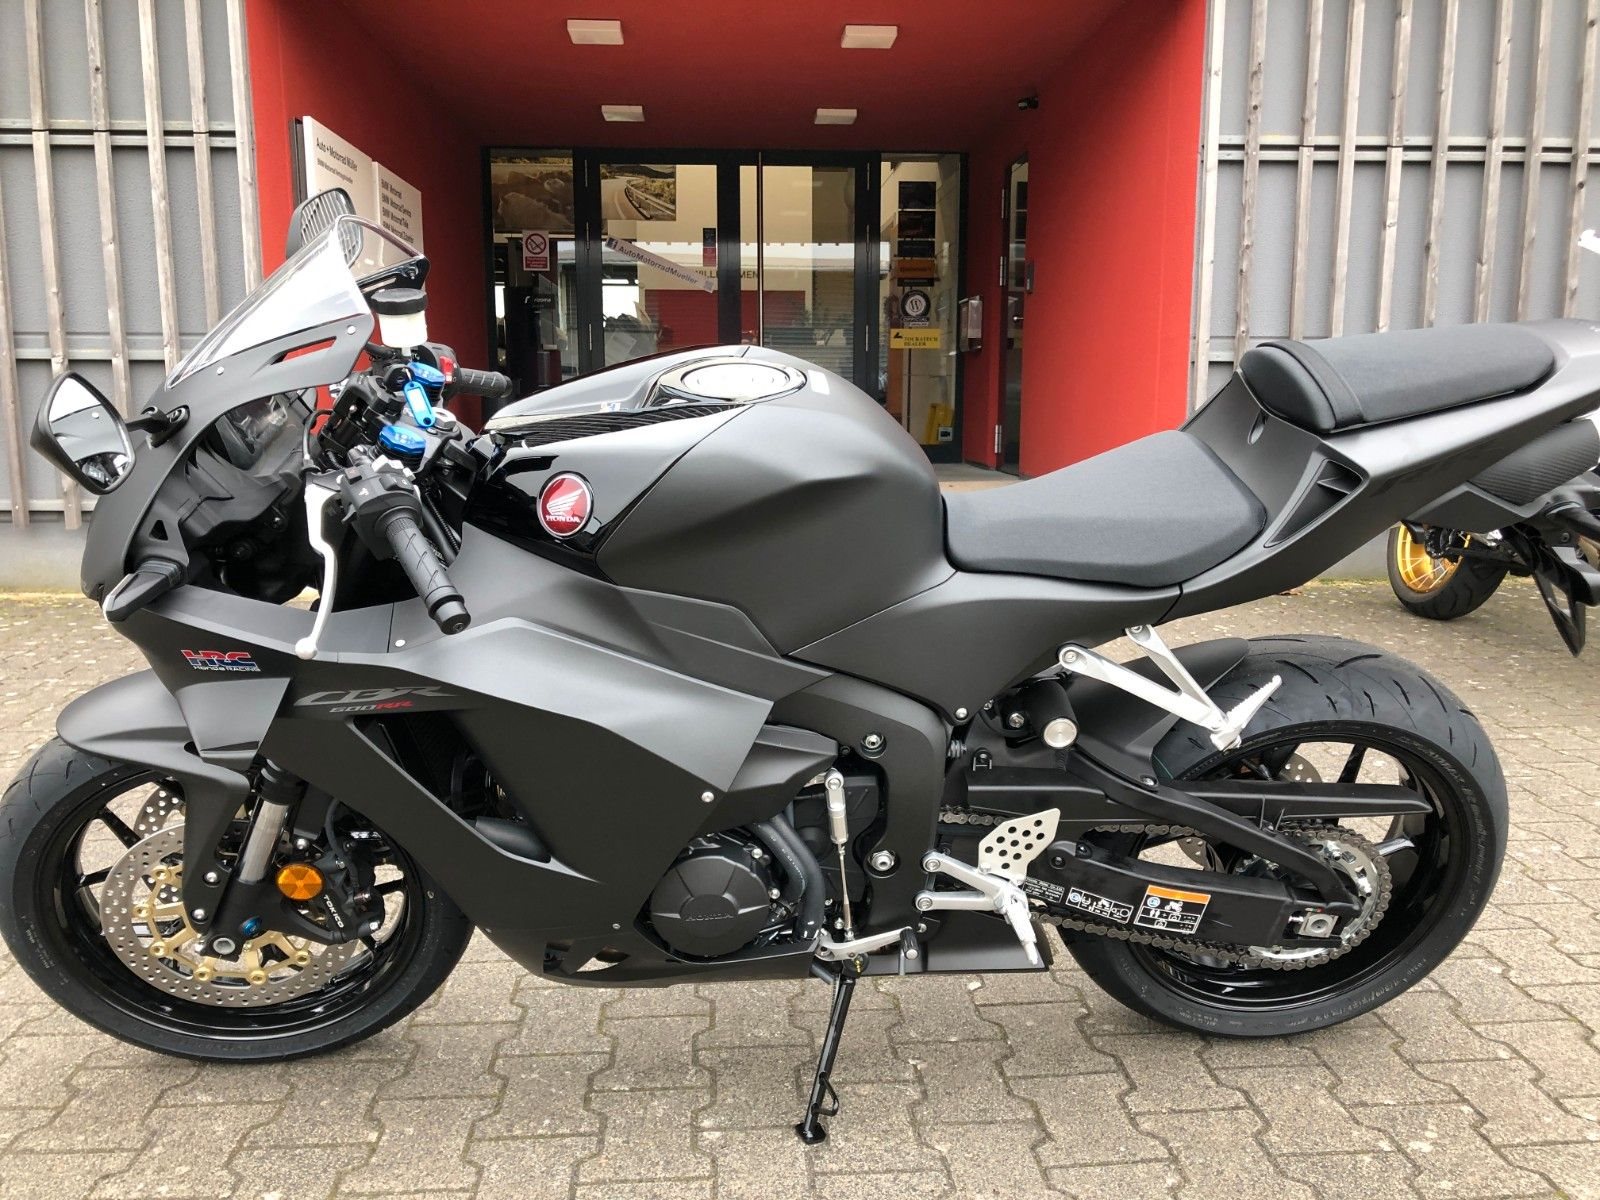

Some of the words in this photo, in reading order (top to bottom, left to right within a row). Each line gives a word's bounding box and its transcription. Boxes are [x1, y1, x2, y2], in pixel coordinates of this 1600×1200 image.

[618, 245, 698, 284] AutoMotorradMueller
[545, 515, 581, 523] HONDA
[180, 649, 259, 668] HRC
[293, 685, 459, 706] CBR
[328, 700, 414, 713] 600RR
[323, 894, 345, 928] TOKICO
